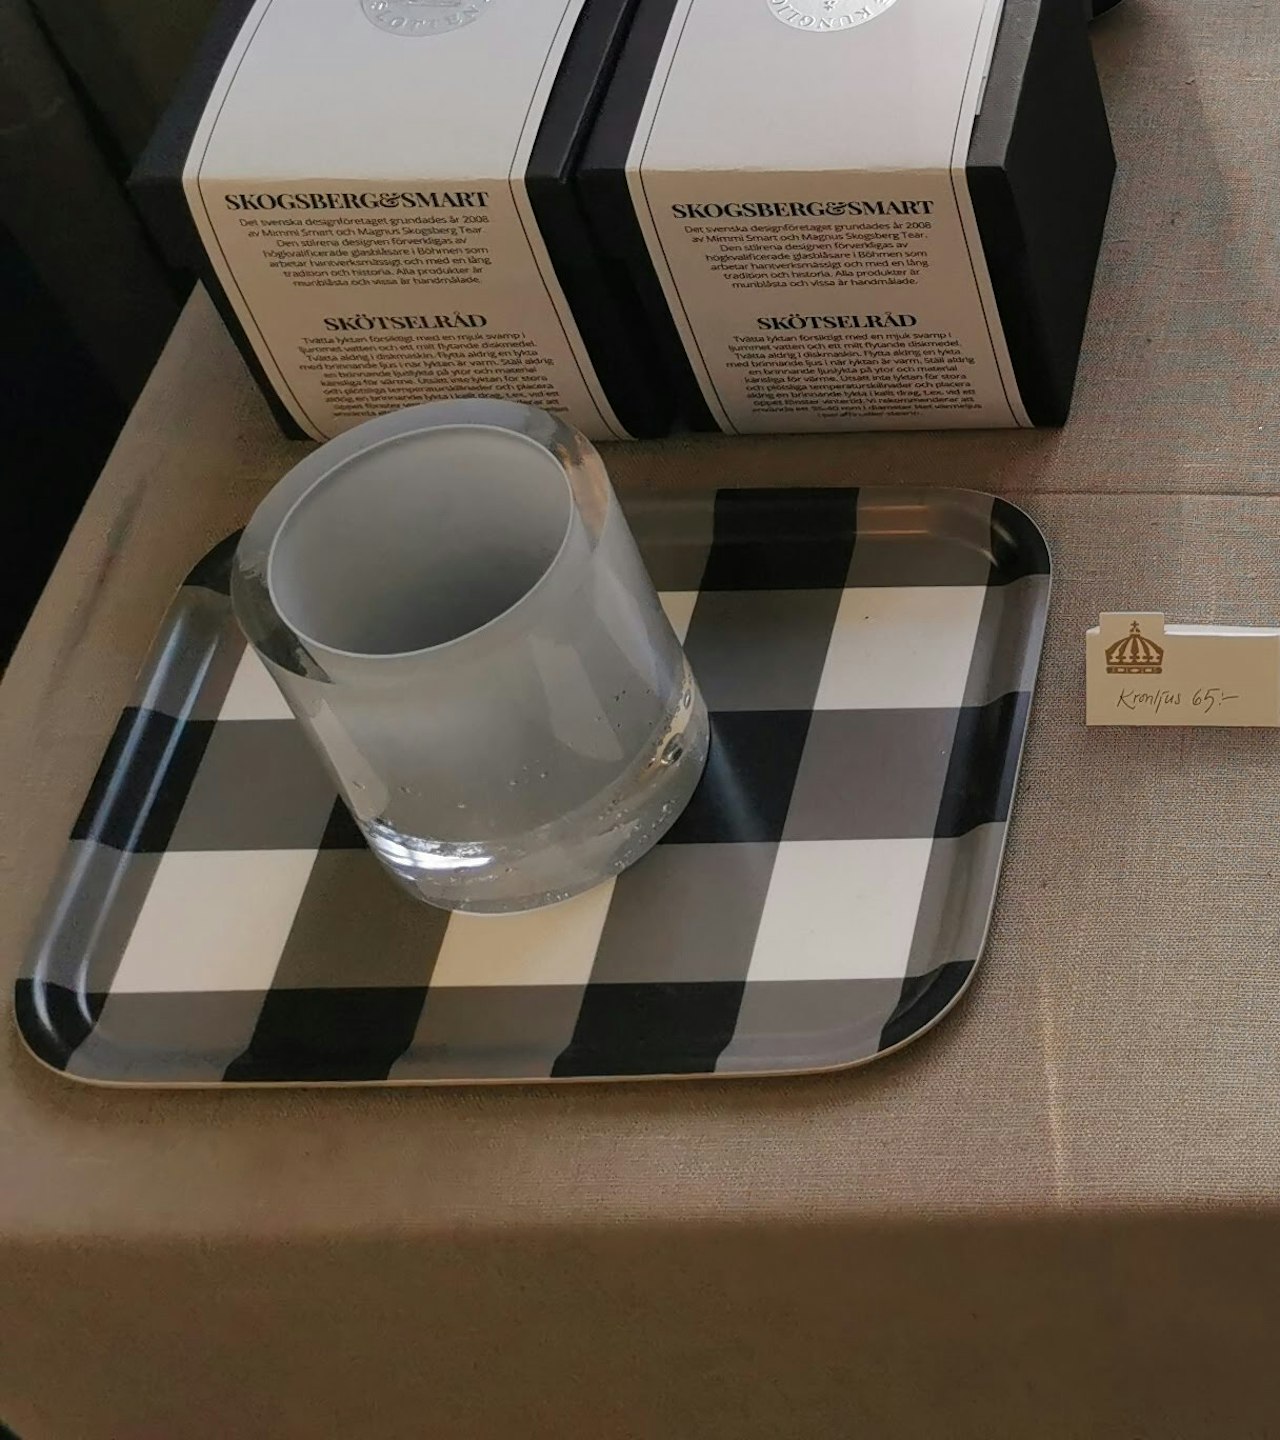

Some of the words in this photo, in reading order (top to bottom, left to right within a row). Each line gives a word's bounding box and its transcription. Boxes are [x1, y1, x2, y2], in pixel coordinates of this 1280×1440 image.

[225, 193, 489, 209] SKOGSBERG&SMART
[672, 201, 934, 218] SKOGSBERG&SMART
[324, 314, 487, 330] SKÖTSELRÅD
[757, 314, 917, 329] SKÖTSELRÅD
[1117, 688, 1181, 714] Kronljus
[1192, 688, 1240, 713] 65:-
